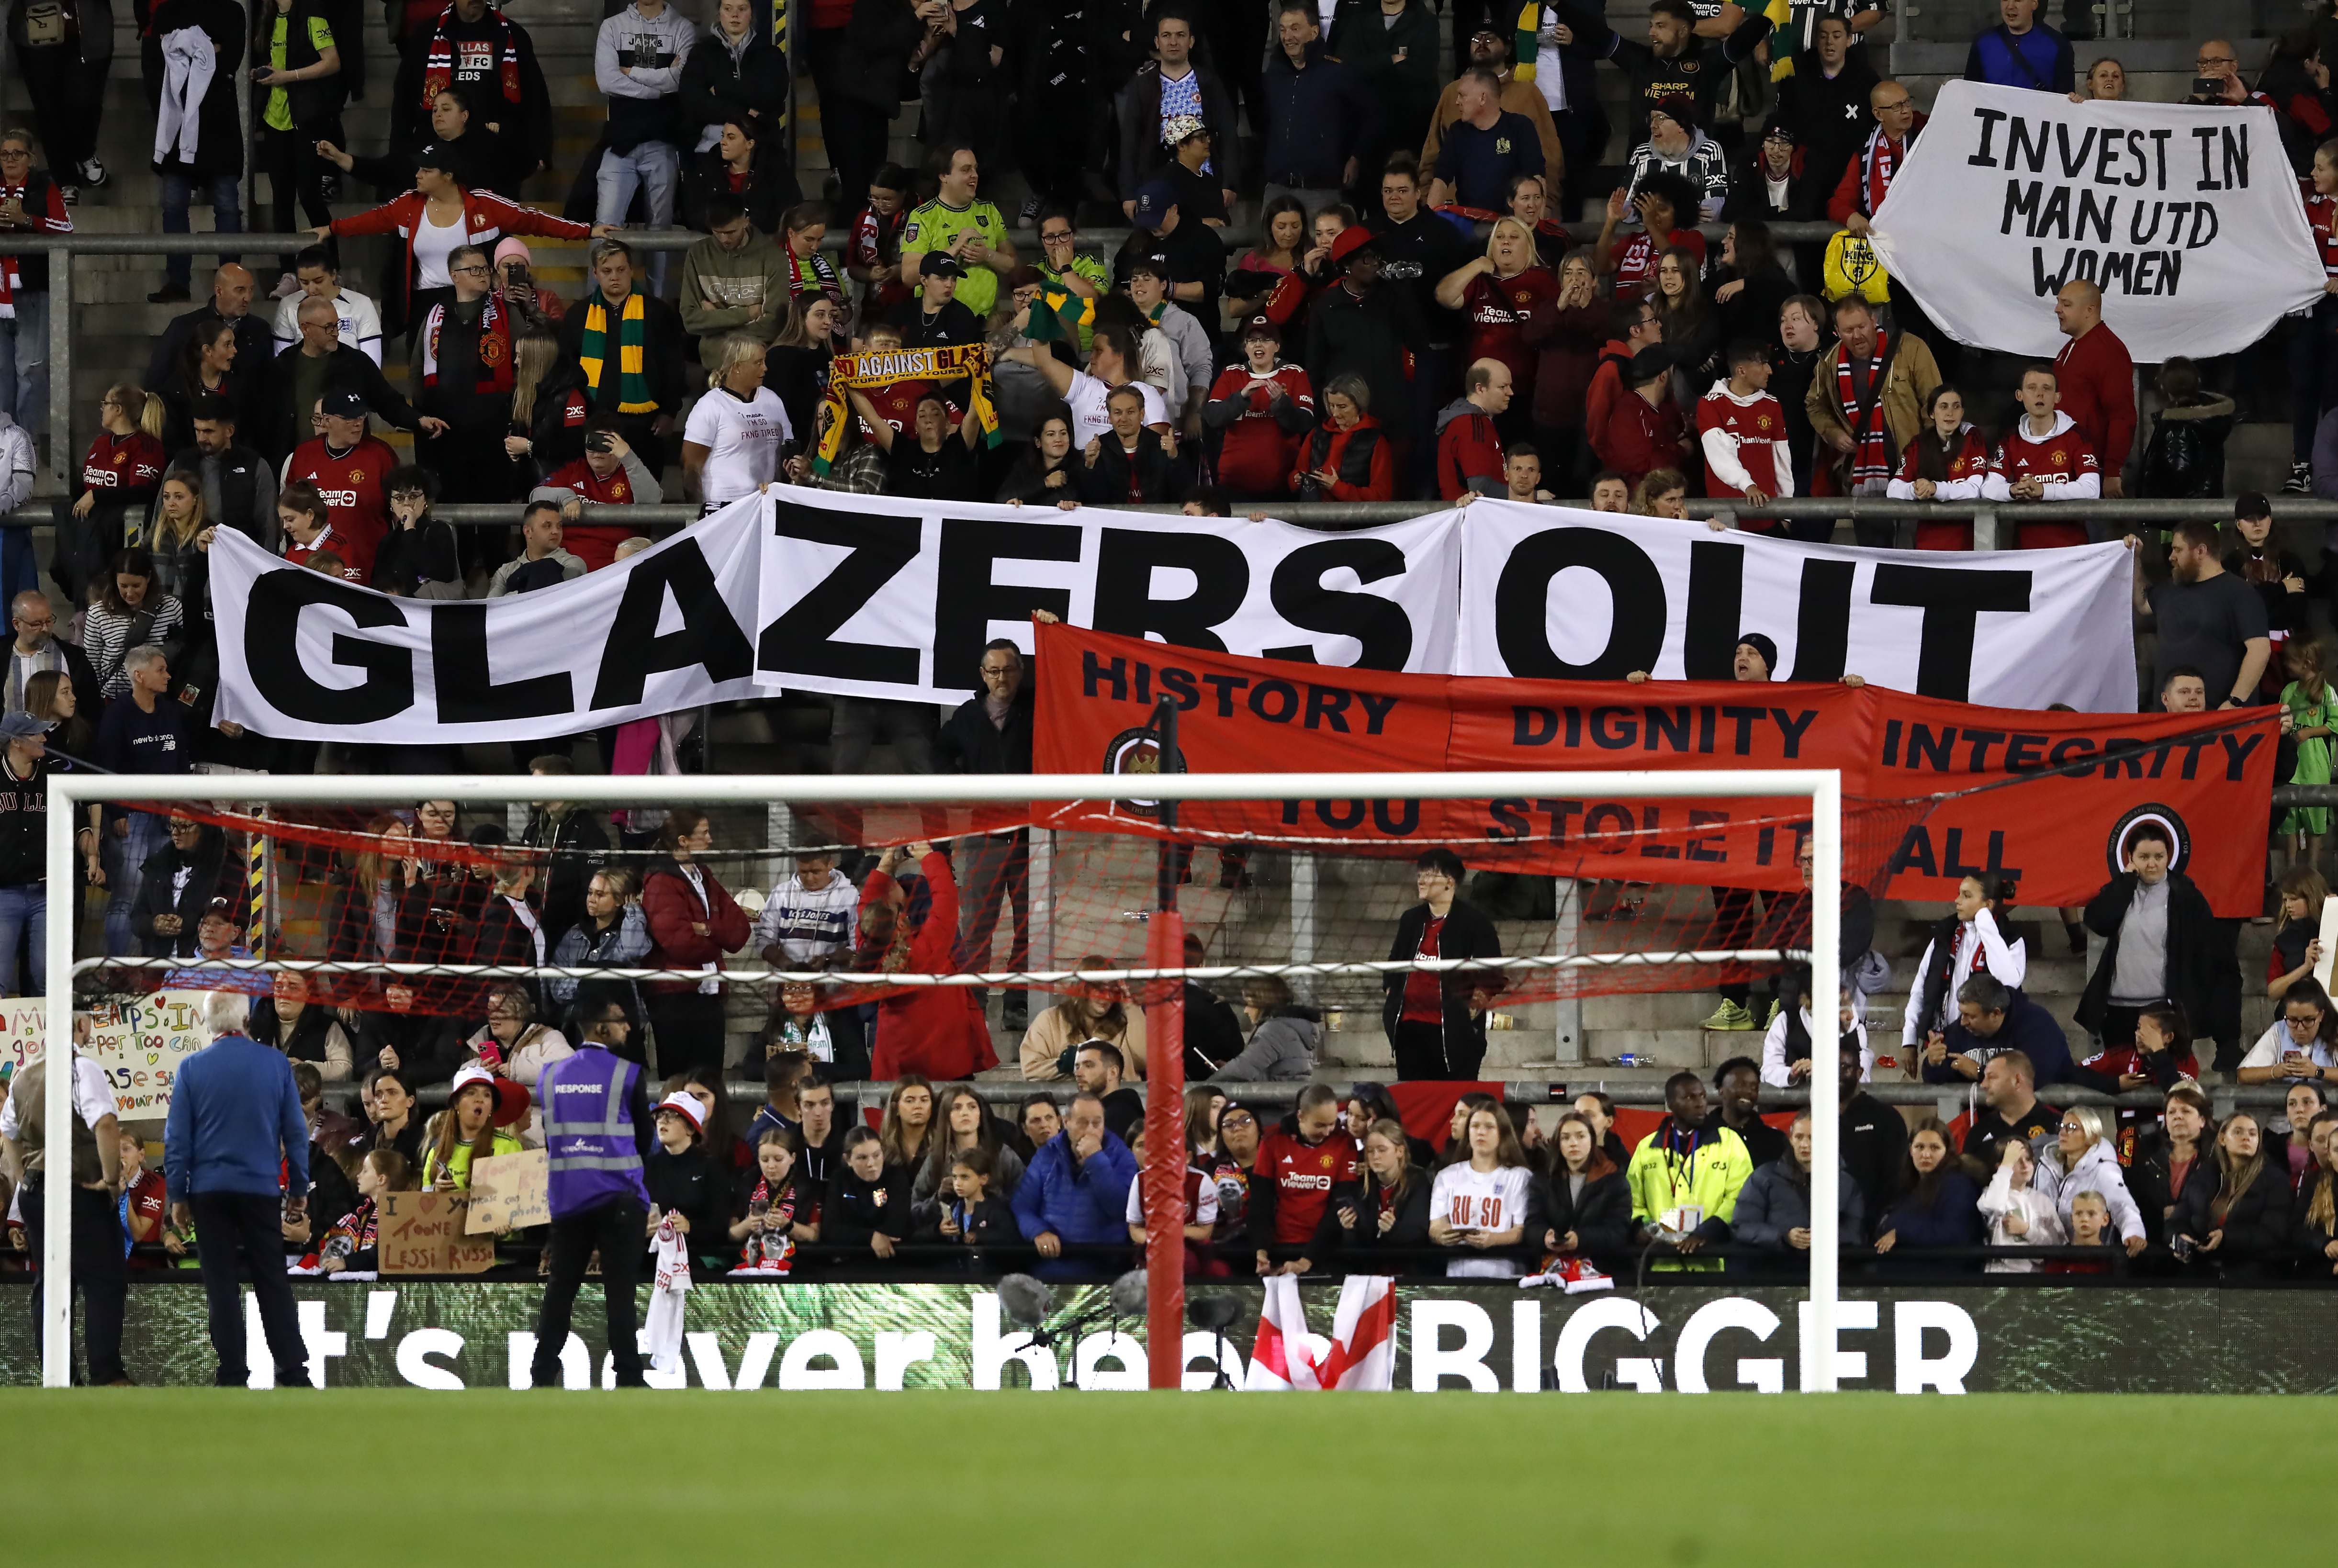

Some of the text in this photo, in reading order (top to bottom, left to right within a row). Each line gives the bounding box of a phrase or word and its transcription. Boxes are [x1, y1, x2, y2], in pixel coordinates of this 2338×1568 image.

[458, 43, 490, 52] LLAS
[473, 57, 488, 67] FC
[456, 72, 480, 81] EDS
[1050, 72, 1067, 86] DKNY
[1967, 108, 2172, 191] INVEST
[2192, 123, 2249, 191] IN
[1705, 174, 1728, 186] DXC
[2001, 179, 2218, 249] MAN UTD
[1845, 250, 1873, 261] KING
[2033, 246, 2182, 297] WOMEN
[858, 350, 934, 379] AGAINST
[924, 369, 964, 377] YOURS
[566, 405, 584, 416] DXC
[1084, 414, 1101, 424] FKNG
[741, 428, 780, 440] FKNG TIRED
[85, 465, 105, 478] Team
[136, 464, 159, 479] DXC
[344, 568, 362, 577] DXC
[245, 500, 2033, 725] GLAZERS OUT
[1082, 650, 2264, 782] HISTORY DIGNITY INTEGRITY
[1485, 798, 1730, 864] STOLE
[1889, 825, 2023, 882] ALL
[806, 911, 830, 920] JONES
[555, 1084, 603, 1094] RESPONSE
[1281, 1177, 1316, 1190] Viewer
[1288, 1171, 1316, 1183] Team
[142, 1196, 162, 1210] DXC
[385, 1196, 397, 1216] I
[246, 1291, 466, 1390] It's
[1411, 1297, 1978, 1395] BIGGER
